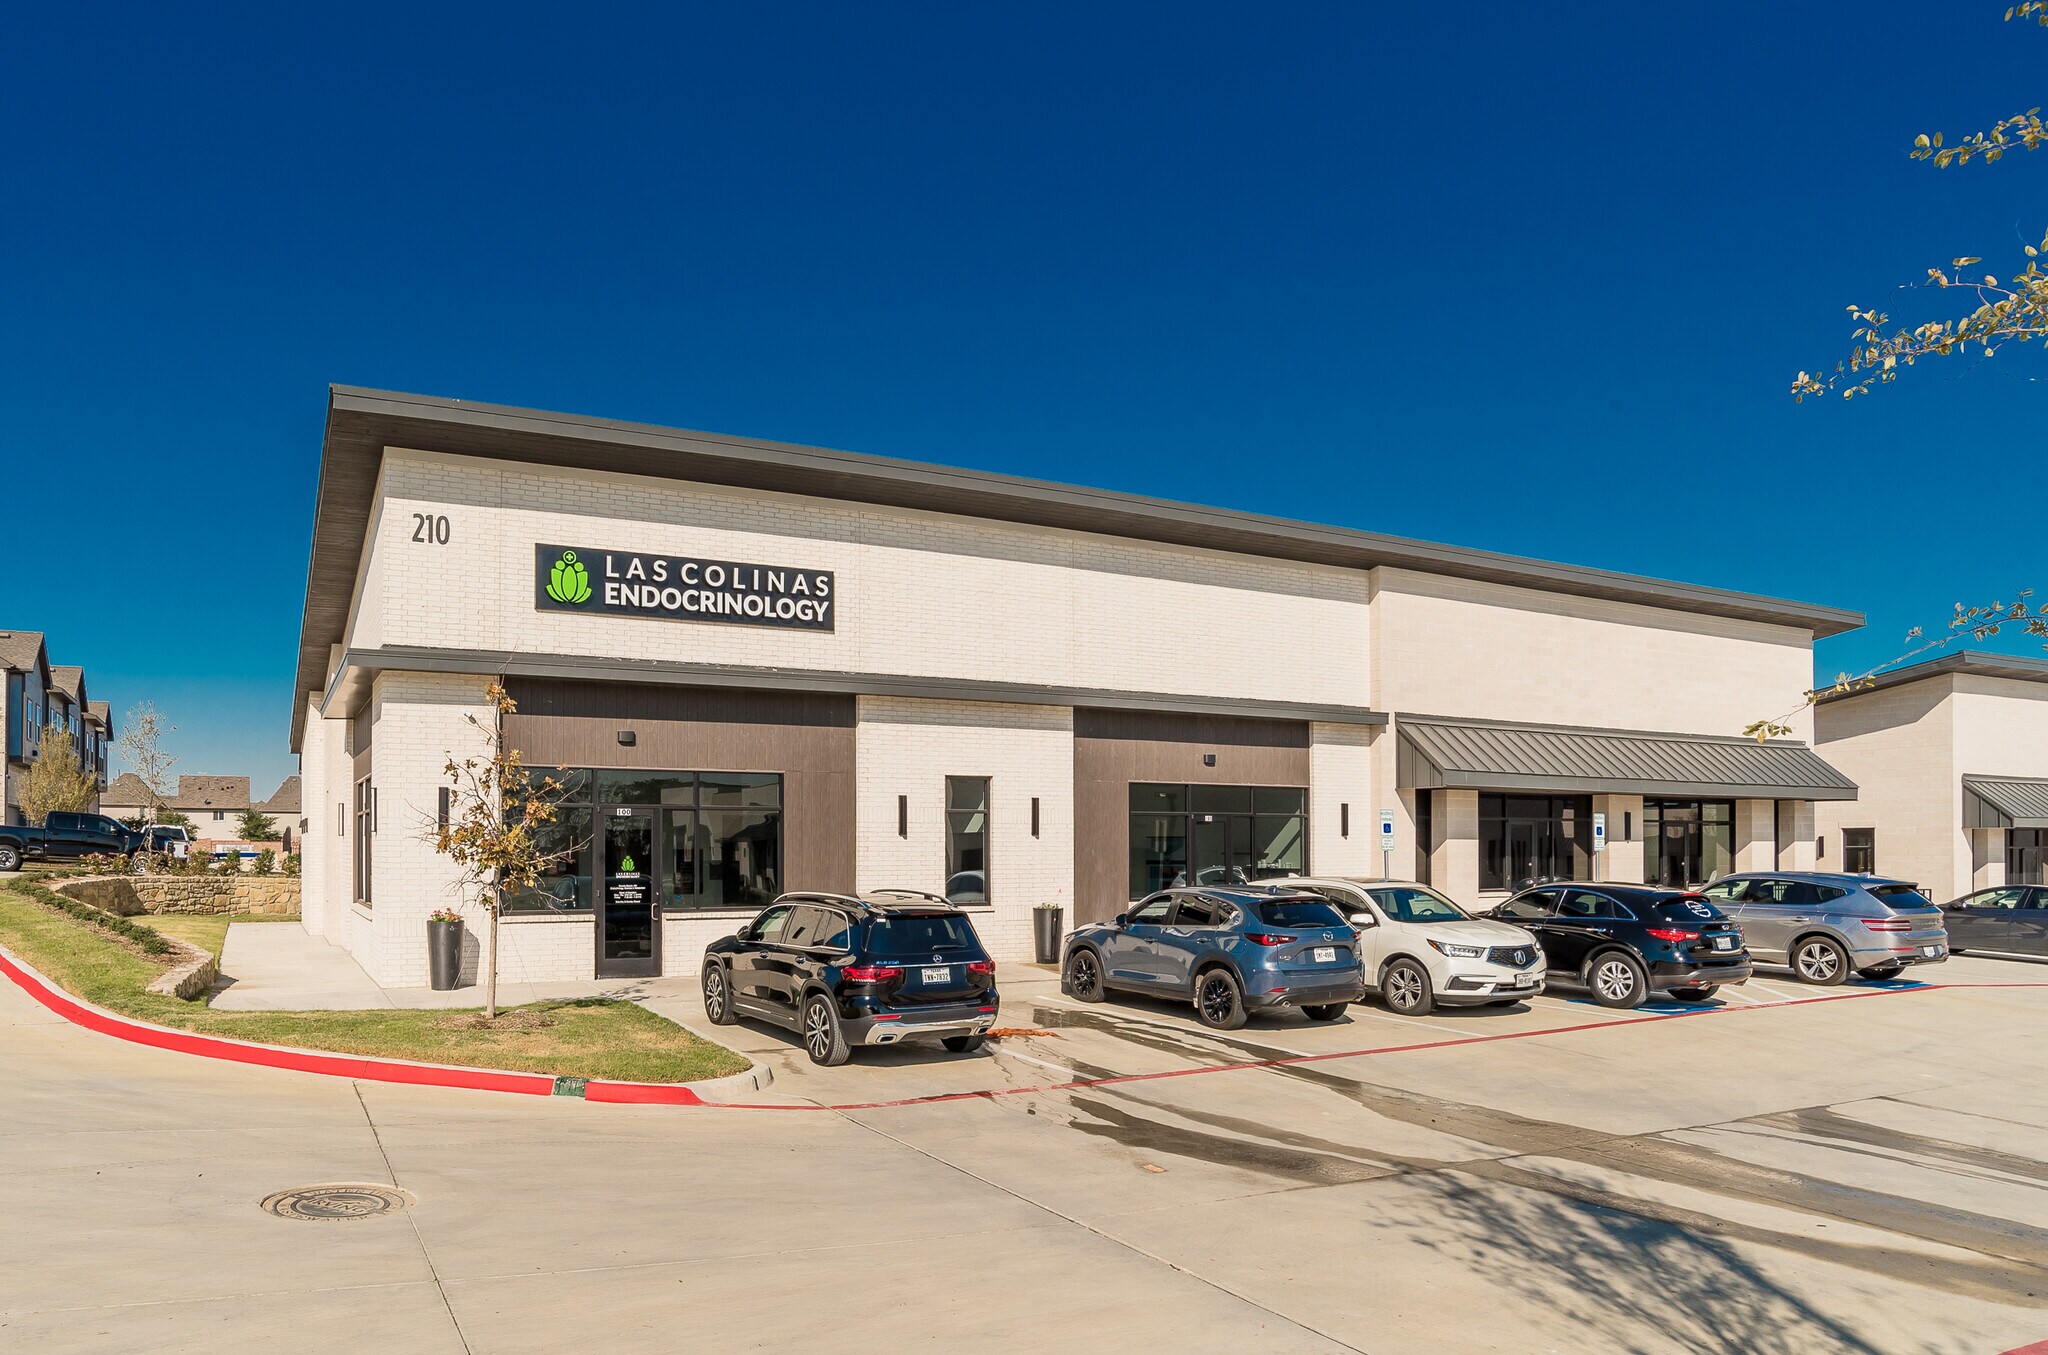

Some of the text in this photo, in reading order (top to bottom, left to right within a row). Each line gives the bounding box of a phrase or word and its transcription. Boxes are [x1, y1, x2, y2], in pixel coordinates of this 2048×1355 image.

[412, 513, 450, 545] 210
[605, 555, 829, 597] LAS COLINAS
[605, 582, 829, 622] ENDOCRINOLOGY
